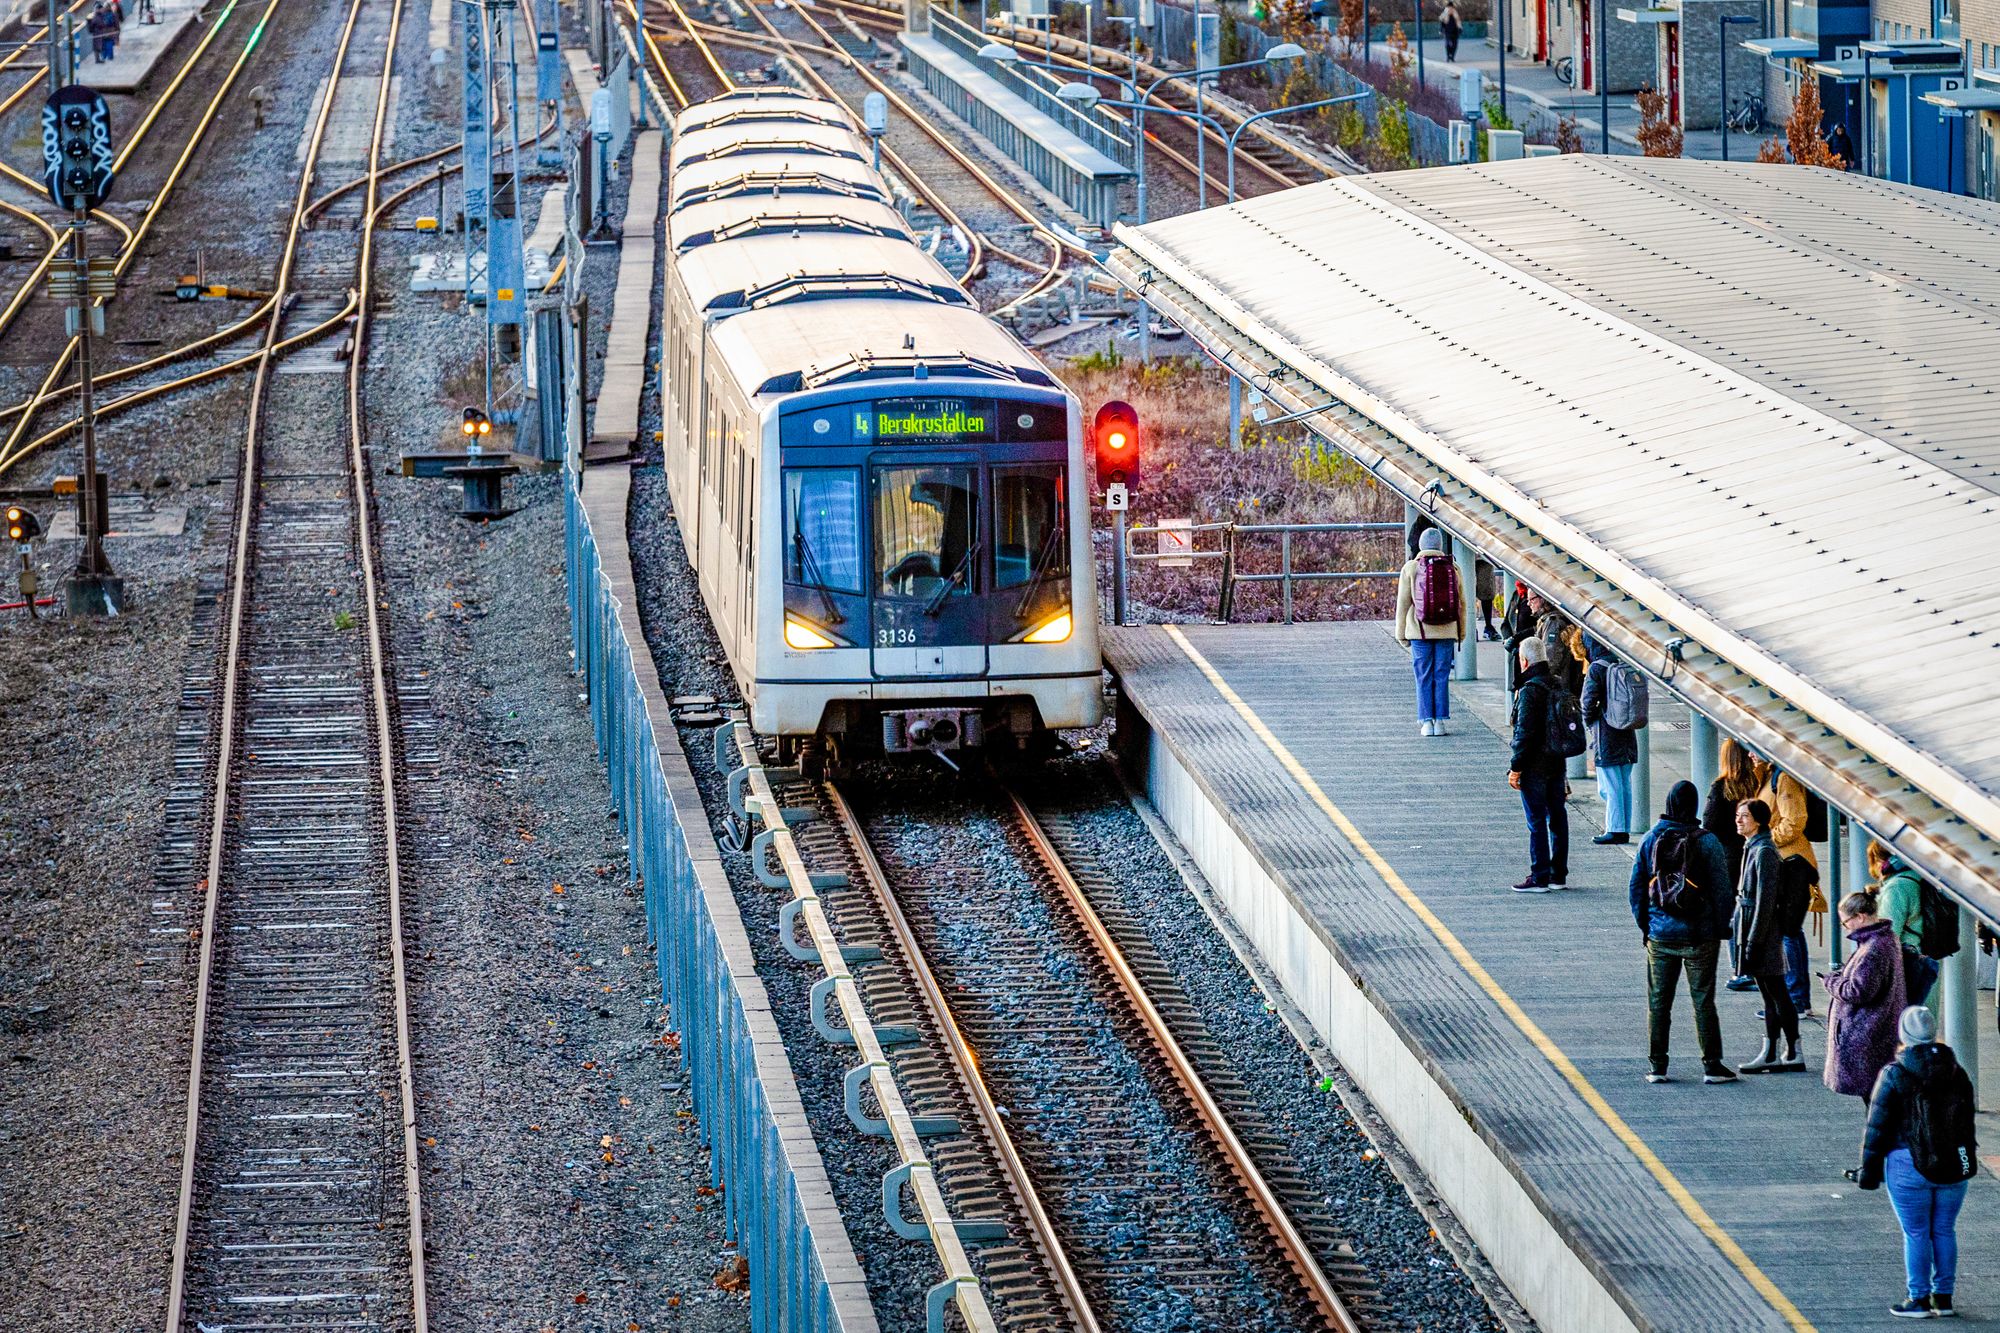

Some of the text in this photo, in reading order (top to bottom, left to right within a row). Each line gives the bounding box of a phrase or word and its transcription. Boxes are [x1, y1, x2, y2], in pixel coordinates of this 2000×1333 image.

[1841, 49, 1853, 60] P
[855, 412, 985, 435] 4 Bergkrystallen
[1112, 493, 1122, 506] S
[879, 628, 916, 644] 3136
